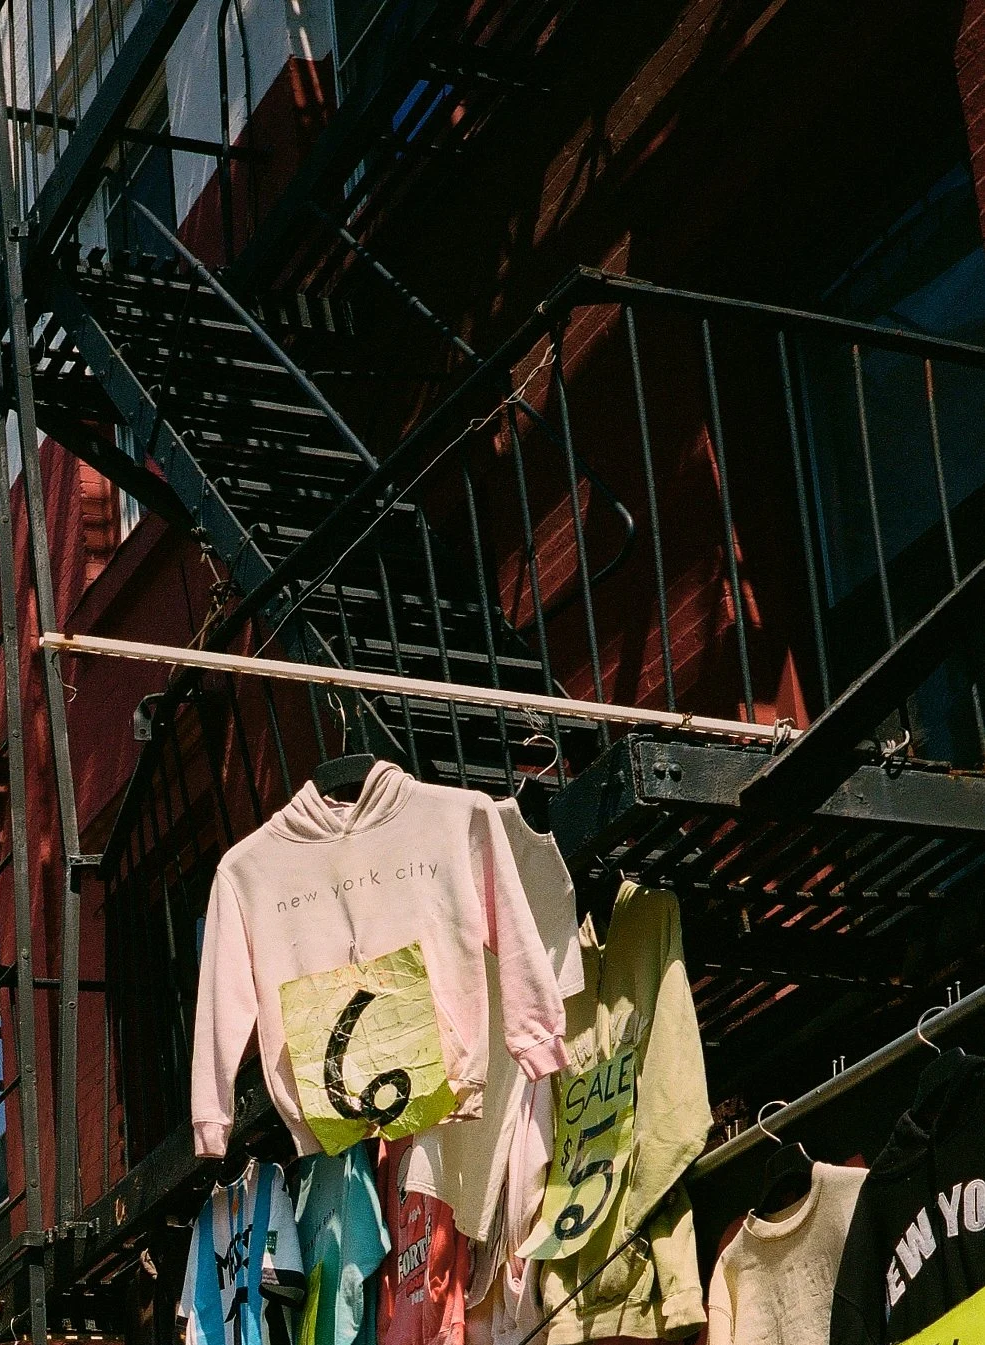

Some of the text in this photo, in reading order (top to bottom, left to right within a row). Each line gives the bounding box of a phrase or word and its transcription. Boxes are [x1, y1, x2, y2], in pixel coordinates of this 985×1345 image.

[276, 860, 440, 914] new york city
[324, 988, 412, 1126] 6
[566, 1050, 633, 1126] SALE
[886, 1206, 937, 1307] EW
